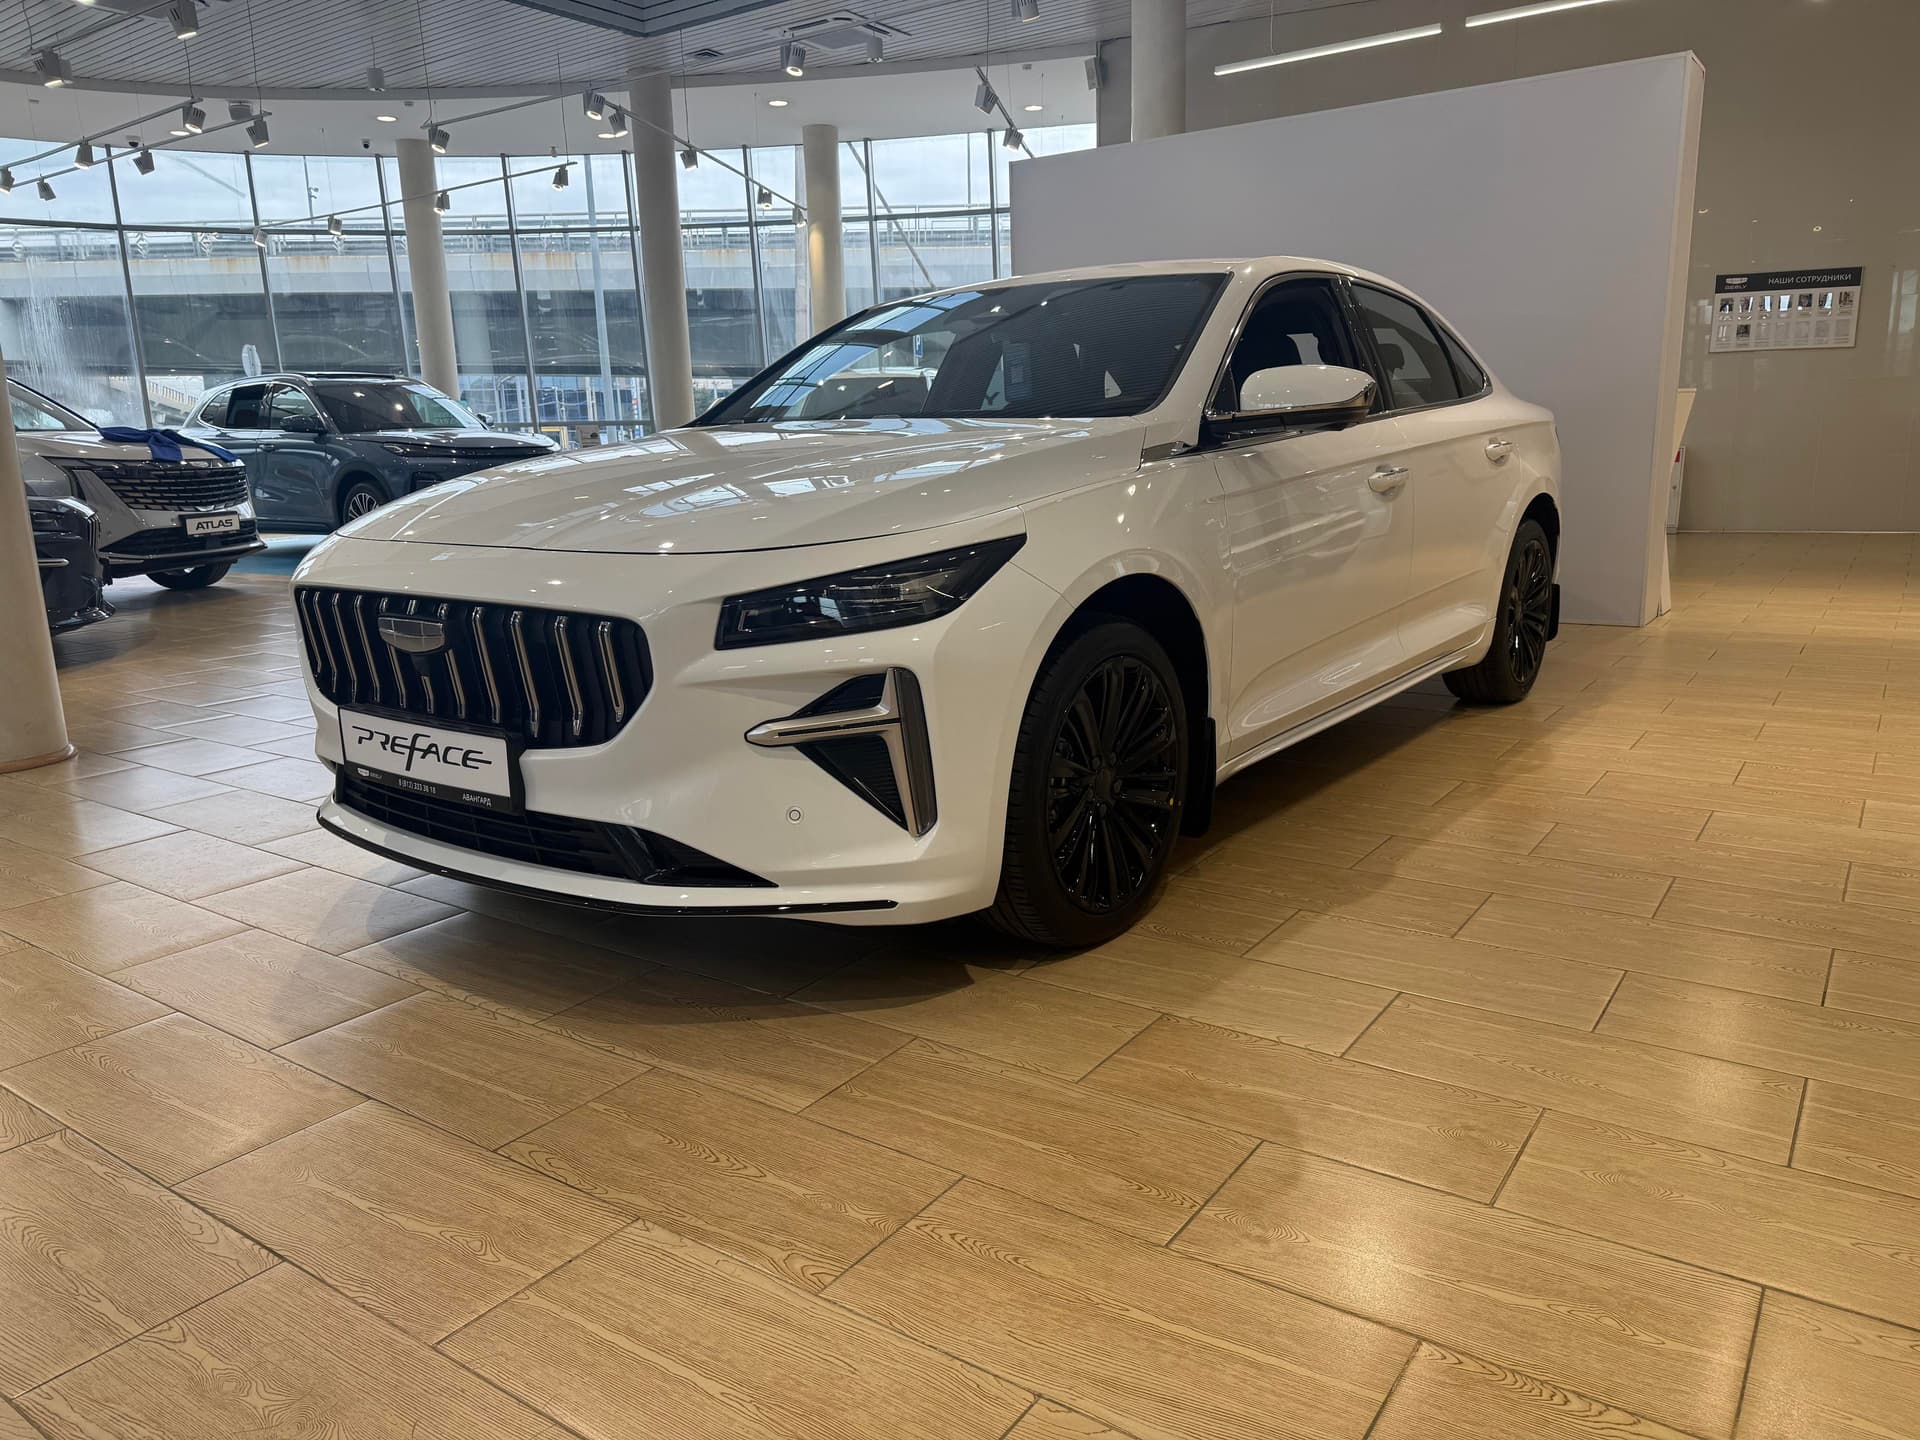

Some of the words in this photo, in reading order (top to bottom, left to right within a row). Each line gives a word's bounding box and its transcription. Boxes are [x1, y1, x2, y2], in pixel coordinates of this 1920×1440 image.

[1768, 276, 1794, 285] НАШИ
[1796, 273, 1852, 284] СОТРУДНИКИ
[196, 519, 233, 530] ATLAS
[352, 725, 492, 771] PREFACE
[462, 793, 492, 808] АВАНГАРД
